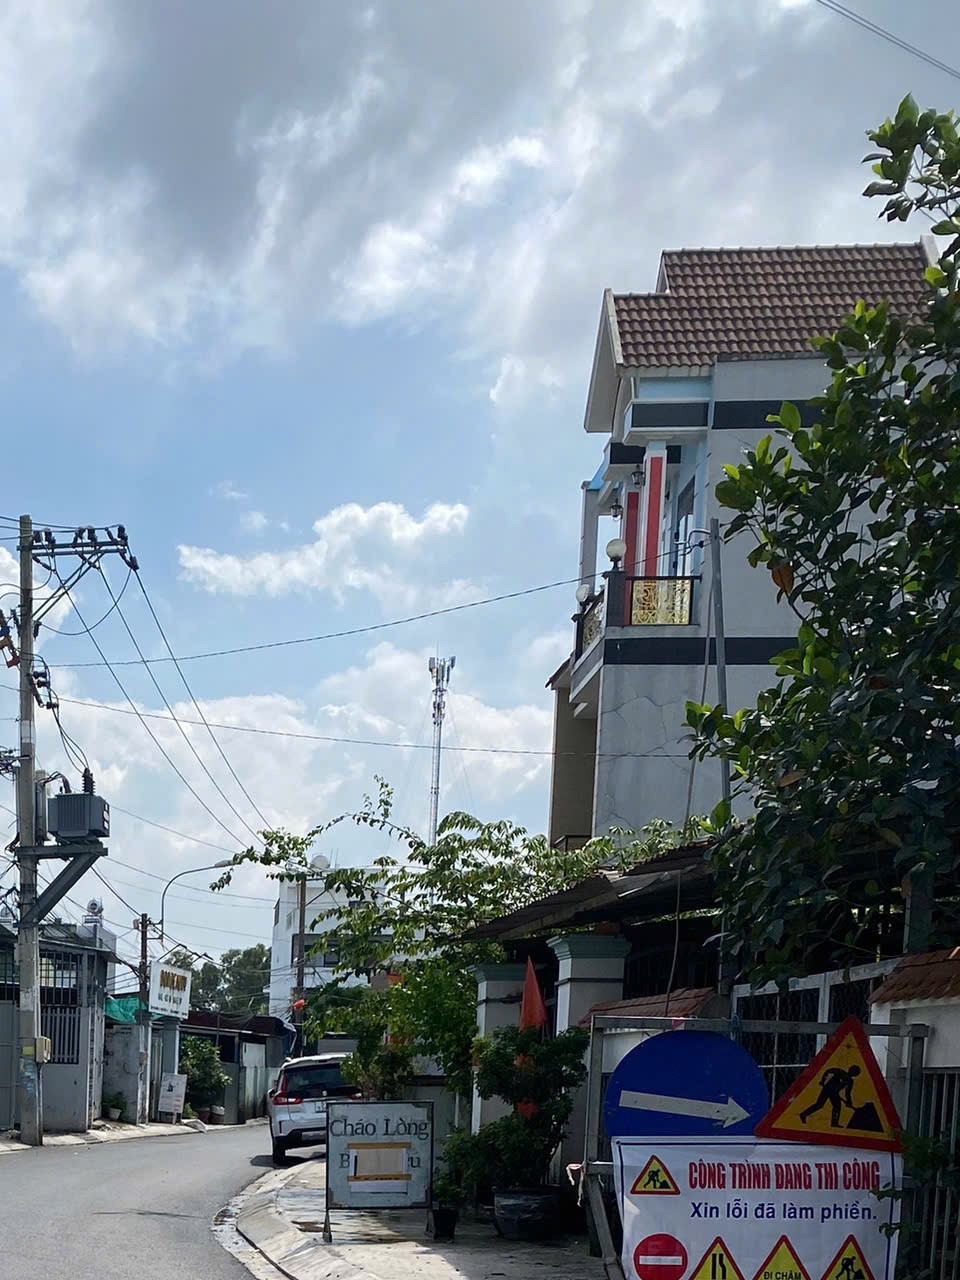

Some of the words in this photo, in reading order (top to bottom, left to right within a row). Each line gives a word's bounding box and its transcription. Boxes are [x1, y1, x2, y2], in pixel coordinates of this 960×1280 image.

[330, 1118, 376, 1136] Cháo
[382, 1117, 430, 1140] Lòng
[688, 1158, 726, 1190] CÔNG
[729, 1160, 771, 1190] TRÌNH
[774, 1162, 812, 1190] ĐANG
[815, 1162, 839, 1190] THI
[842, 1158, 881, 1191] CÔNG
[690, 1202, 720, 1218] Xin
[726, 1198, 748, 1218] lỗi
[754, 1202, 776, 1219] đã
[782, 1202, 814, 1220] làm
[820, 1200, 877, 1223] phiền.
[763, 1271, 774, 1280] ĐI
